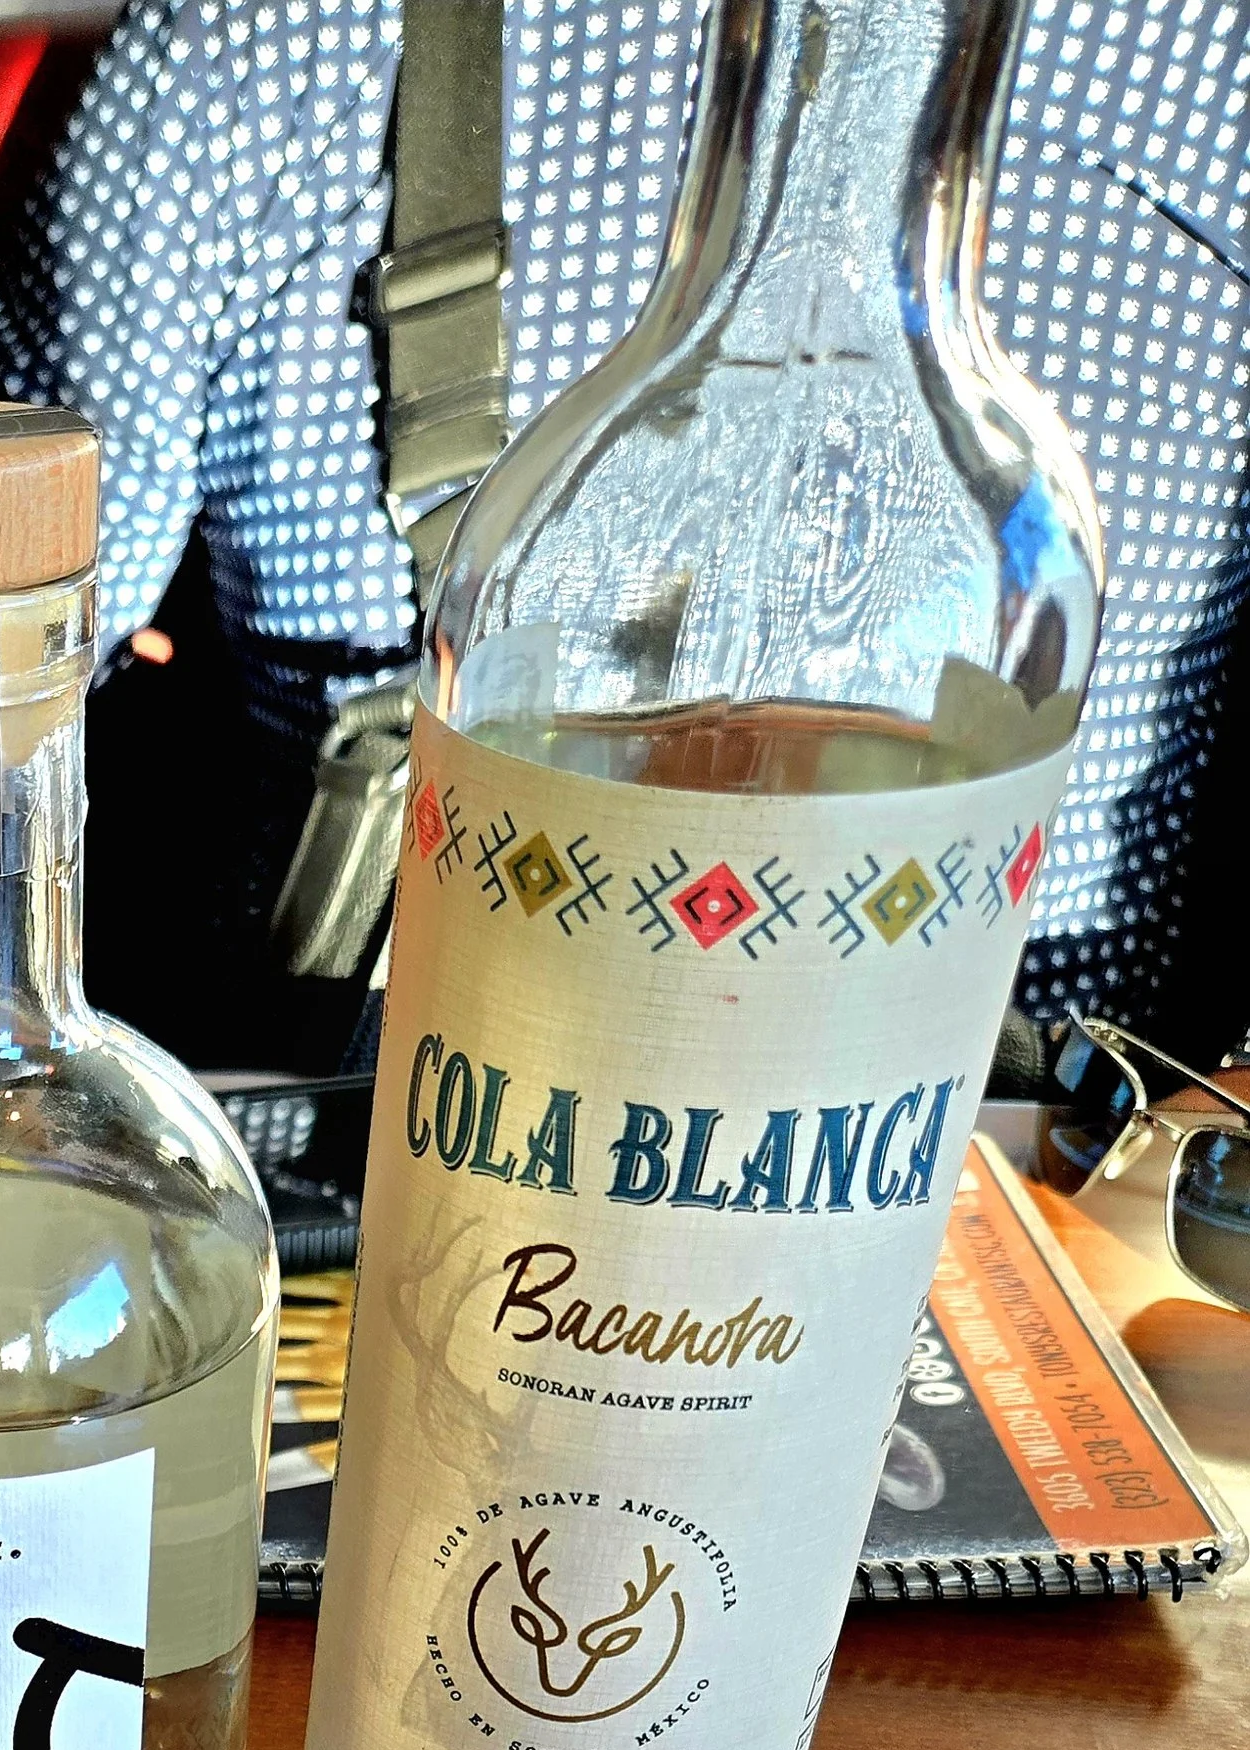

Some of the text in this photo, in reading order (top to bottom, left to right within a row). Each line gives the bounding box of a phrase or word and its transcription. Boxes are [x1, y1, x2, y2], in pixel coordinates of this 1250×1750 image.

[405, 1032, 583, 1196] COLA
[491, 1242, 806, 1371] Bacanora
[497, 1367, 753, 1412] SONORAN AGAVE SPIRIT
[1001, 1409, 1071, 1469] TWEEDY
[1035, 1472, 1095, 1513] 3605
[1094, 1471, 1170, 1510] (323)
[433, 1492, 738, 1612] 100% DE AGAVE ANGUSTIFOLIA
[425, 1634, 463, 1704] HECHO
[468, 1712, 496, 1738] EN
